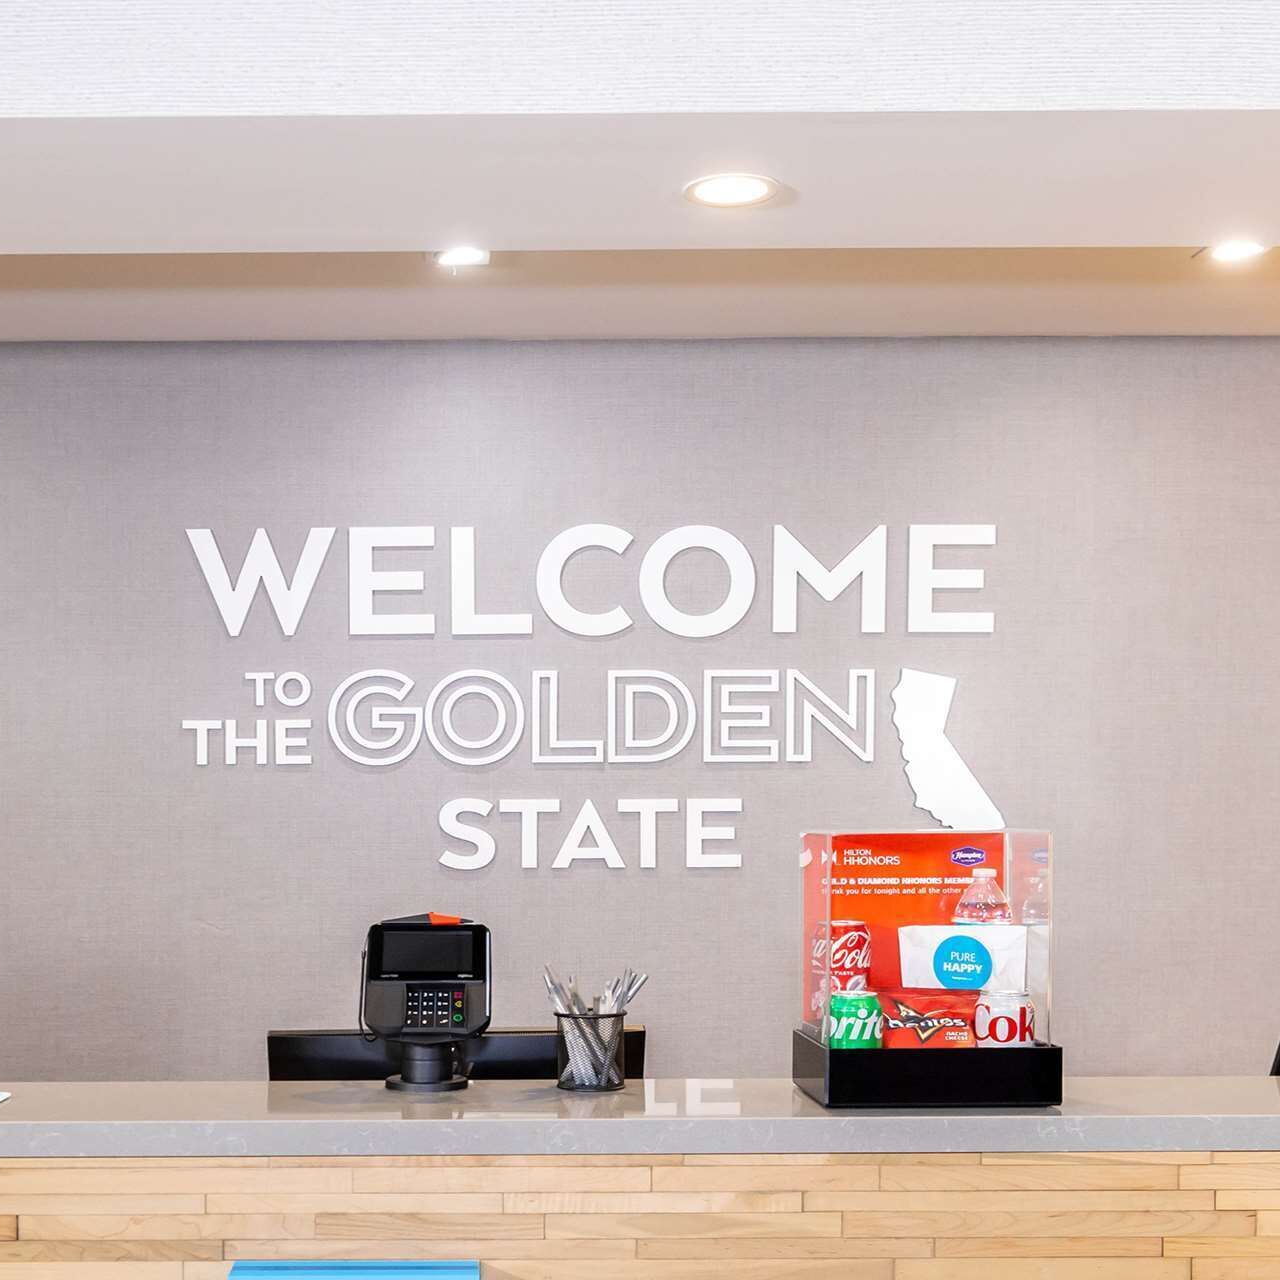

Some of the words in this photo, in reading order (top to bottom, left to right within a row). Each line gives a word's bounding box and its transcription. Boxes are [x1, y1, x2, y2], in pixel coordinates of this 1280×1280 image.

[185, 522, 998, 638] WELCOME
[245, 671, 312, 710] TO
[182, 719, 313, 767] THE
[326, 668, 877, 767] GOLDEN
[437, 797, 743, 870] STATE
[843, 856, 901, 866] HHONORS
[857, 877, 901, 885] DIAMOND
[902, 877, 943, 885] HHONORS
[845, 888, 860, 896] you
[874, 887, 900, 897] tonight
[902, 887, 916, 895] and
[928, 887, 941, 895] the
[942, 887, 962, 895] other
[950, 951, 976, 963] PURE
[943, 962, 983, 975] HAPPY
